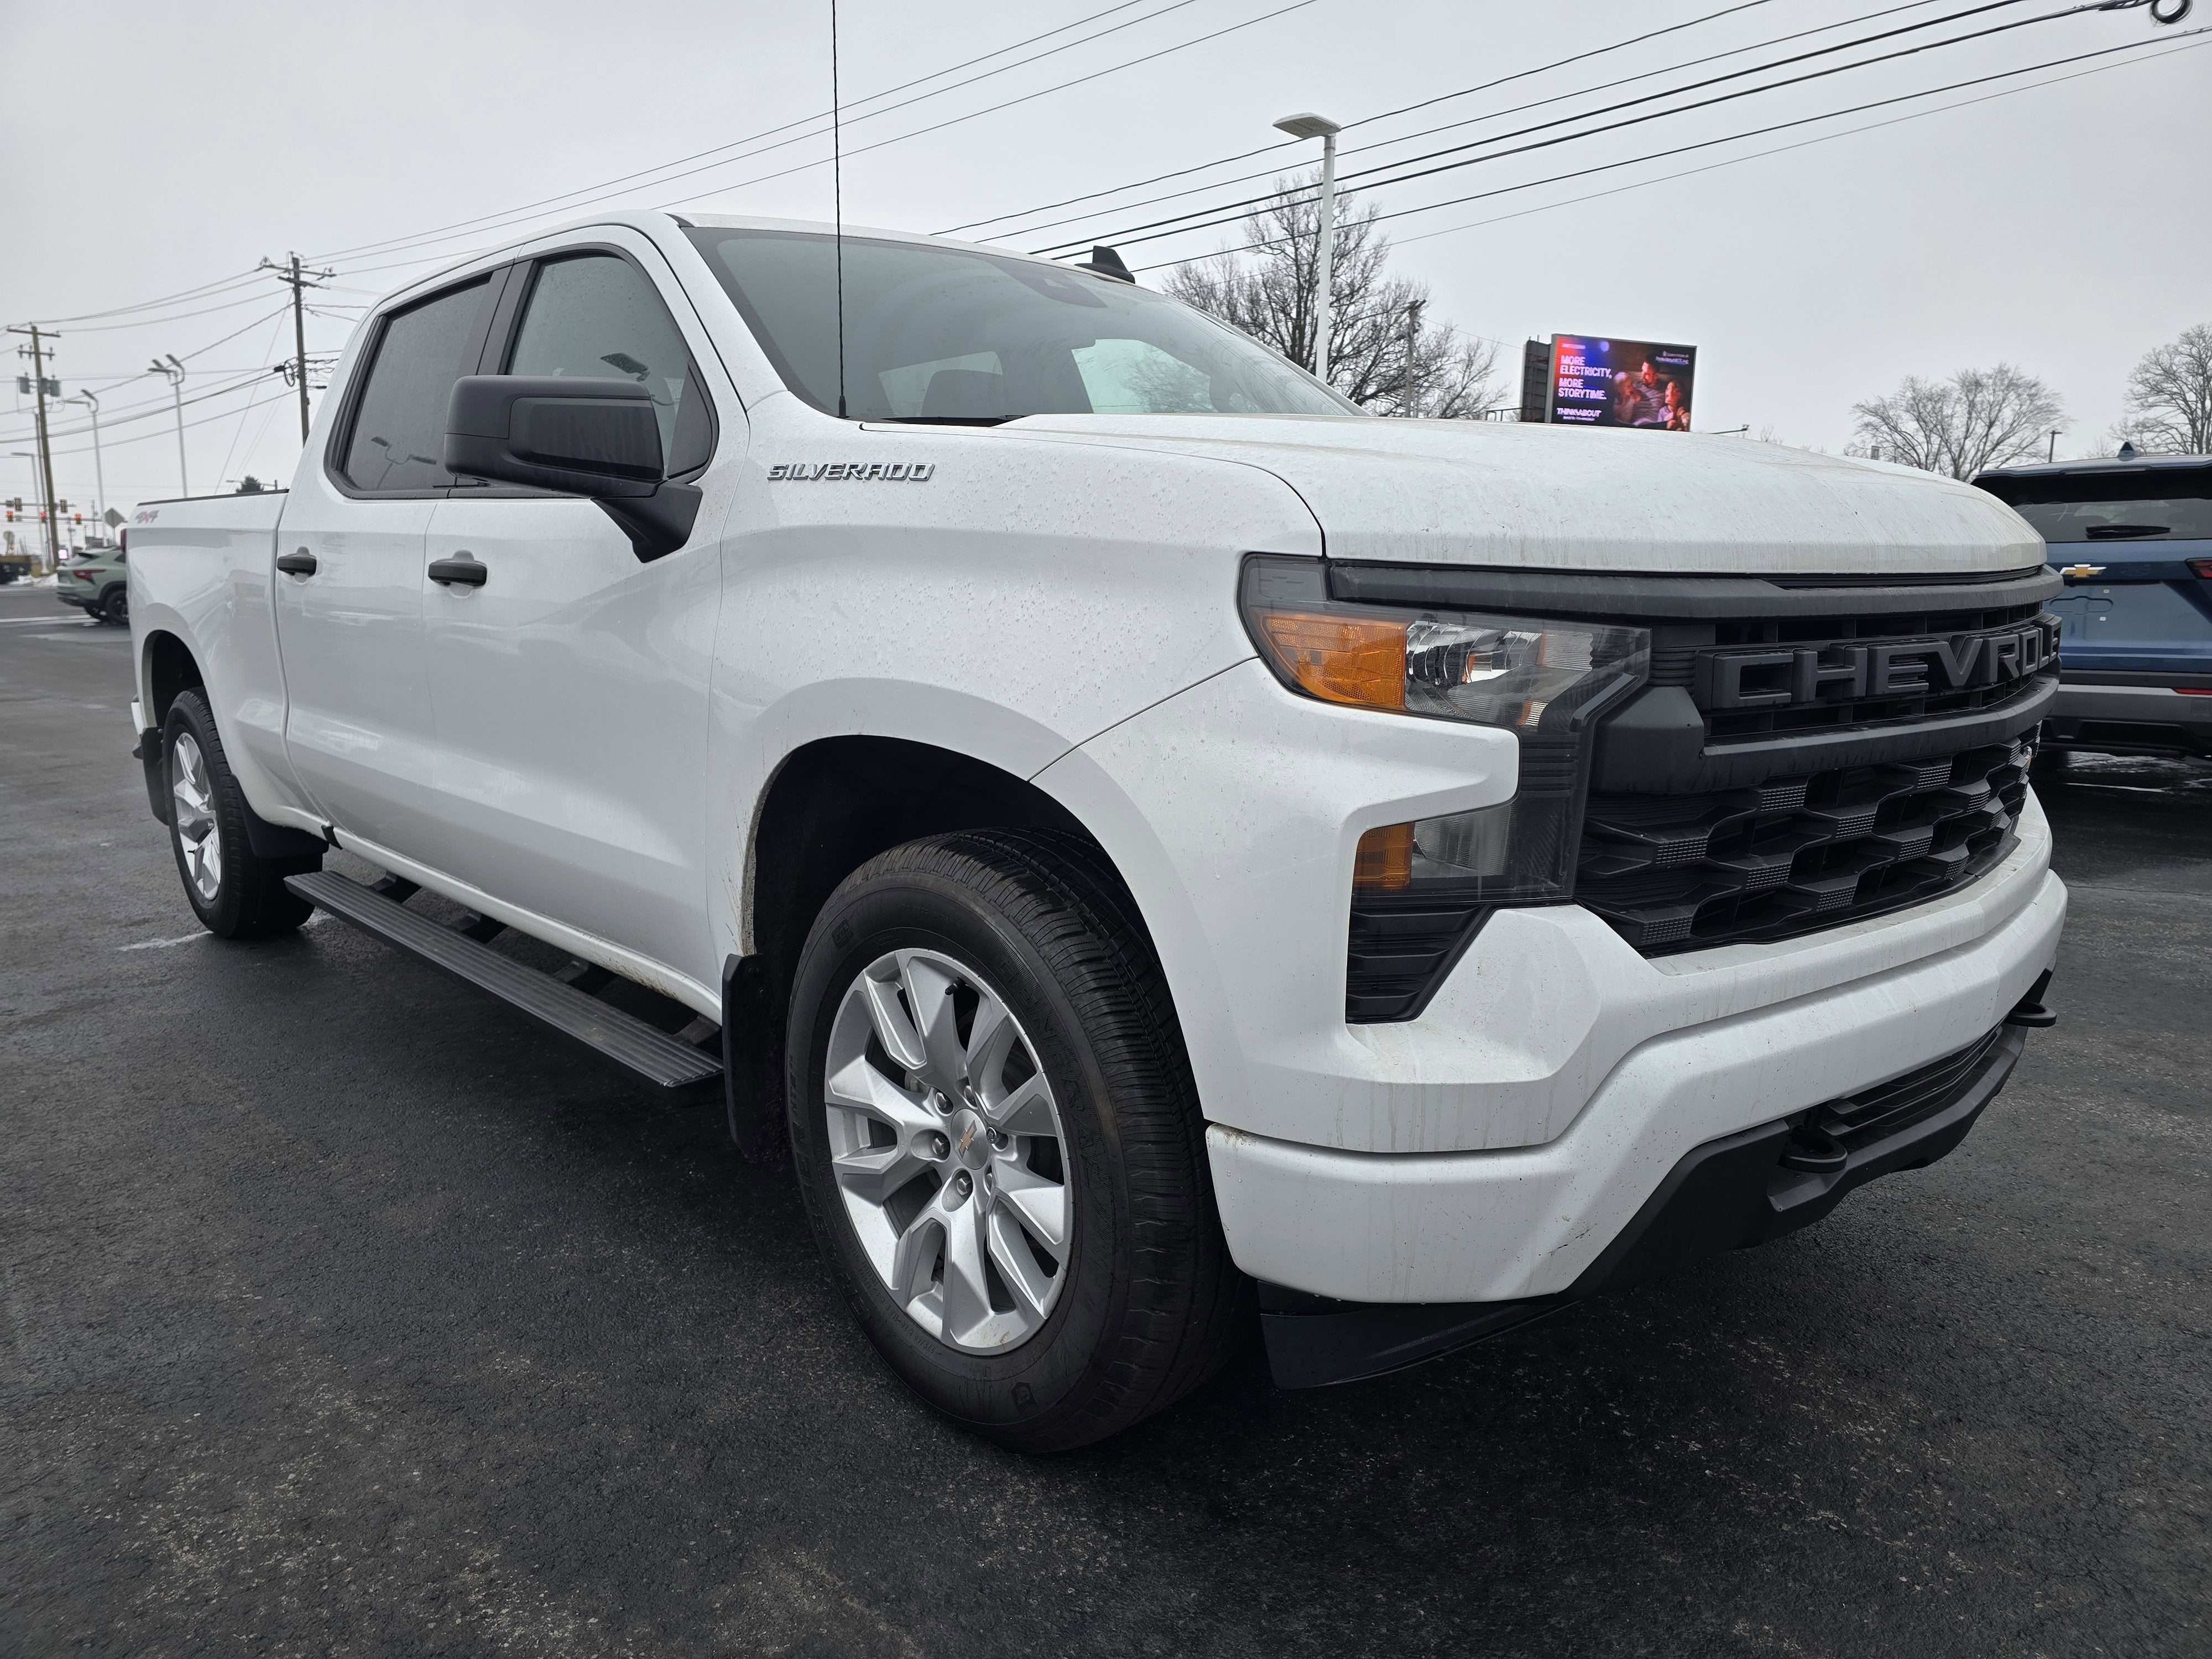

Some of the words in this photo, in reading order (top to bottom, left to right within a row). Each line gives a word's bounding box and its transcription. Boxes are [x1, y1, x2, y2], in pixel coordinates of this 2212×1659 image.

[1561, 355, 1586, 366] MORE
[1560, 365, 1612, 379] ELECTRICITY,
[1559, 378, 1584, 388] MORE
[1558, 388, 1606, 399] STORYTIME.
[767, 462, 935, 481] SILVERADO
